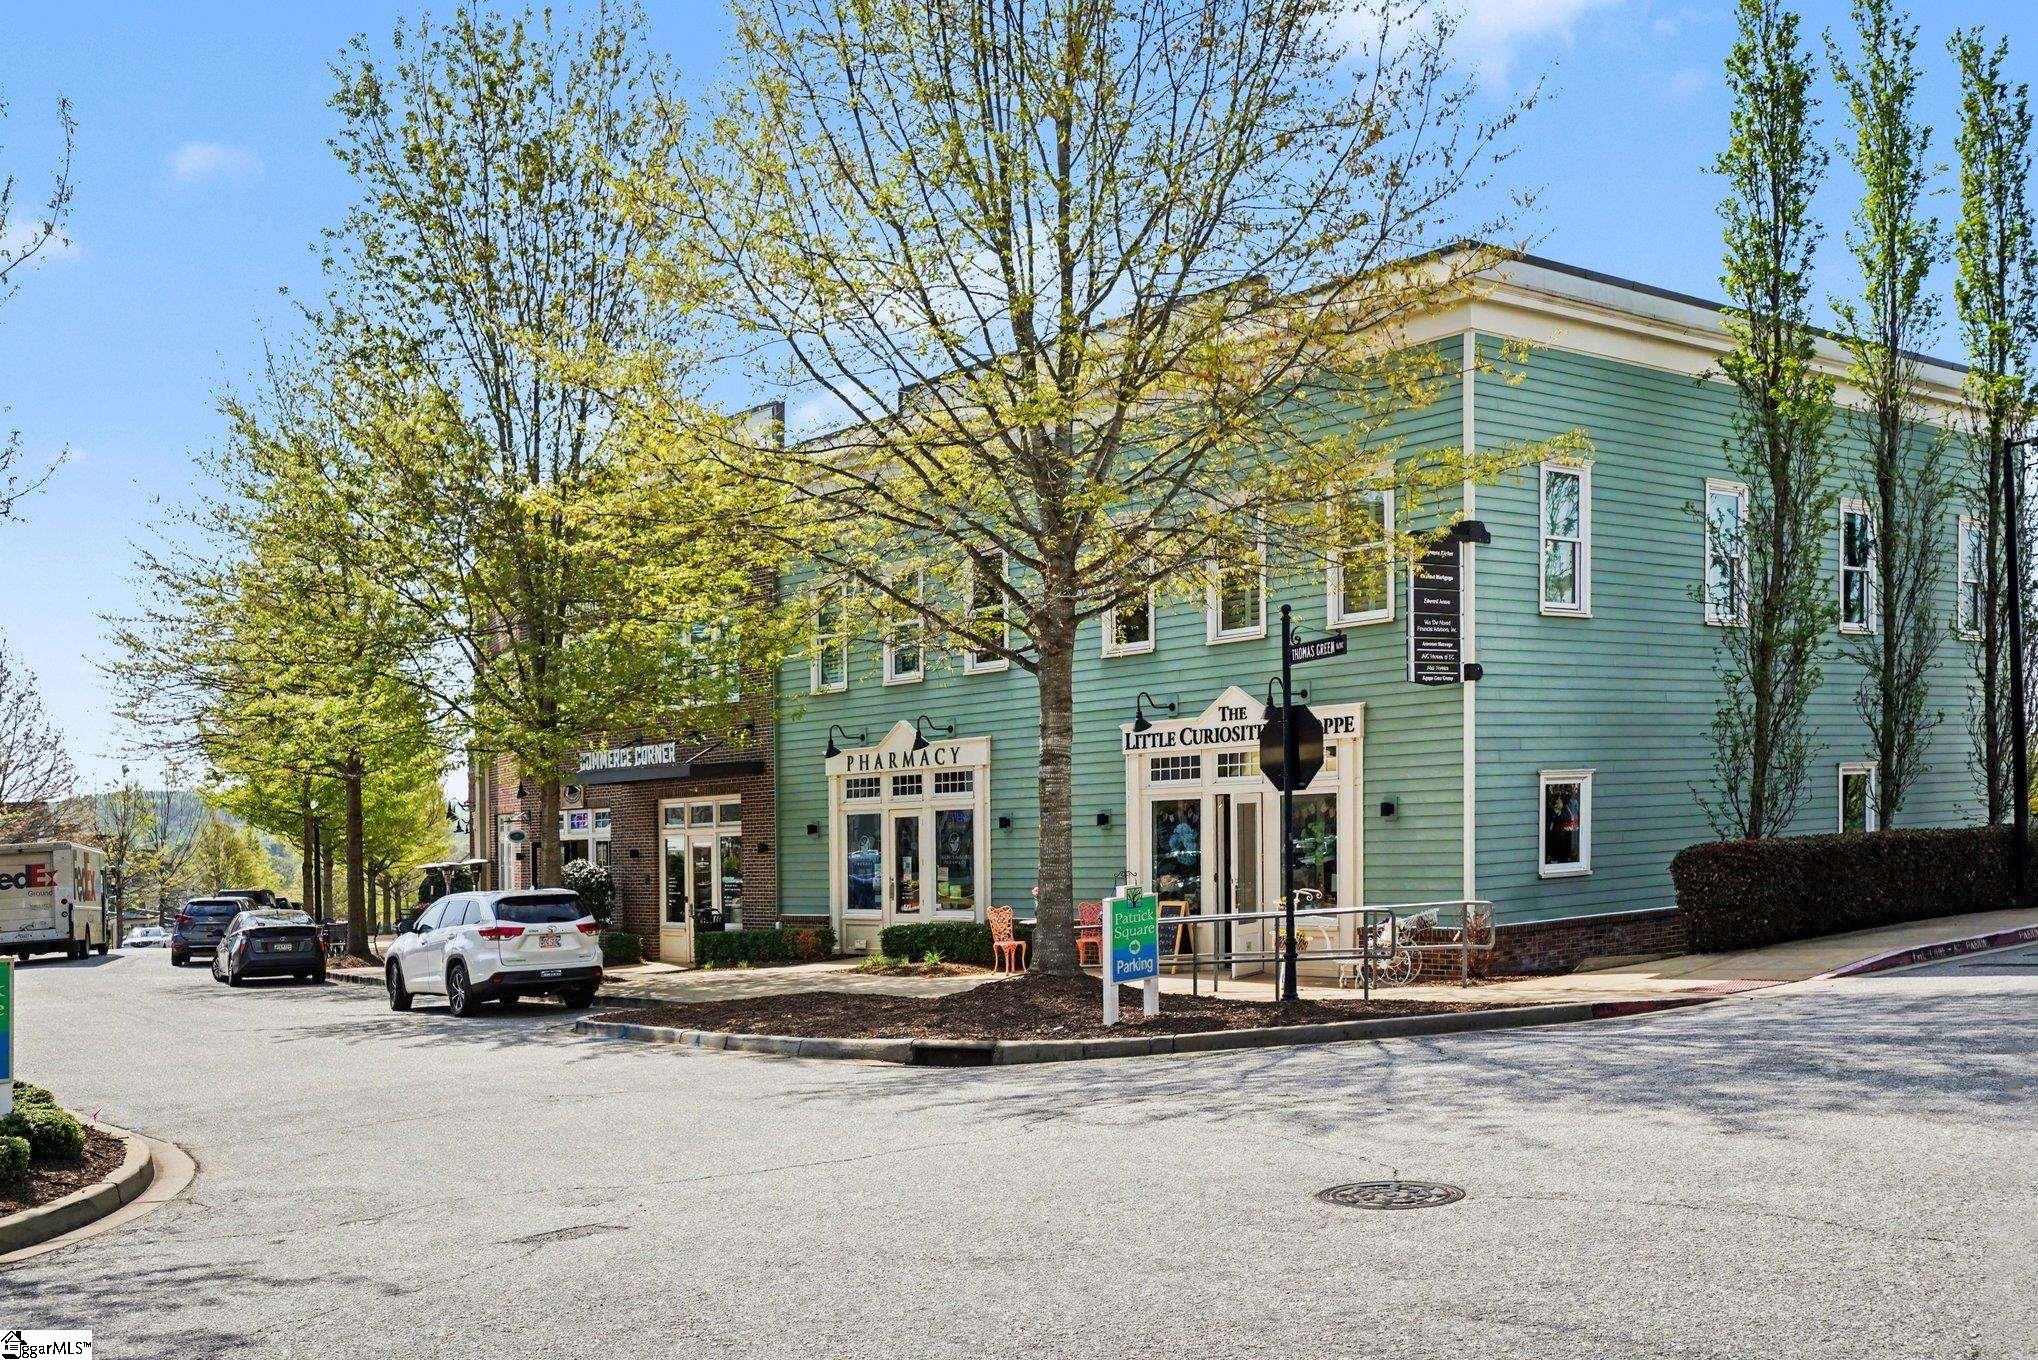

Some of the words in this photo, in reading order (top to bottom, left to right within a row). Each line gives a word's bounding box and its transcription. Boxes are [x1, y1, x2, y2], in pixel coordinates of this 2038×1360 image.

[1291, 645, 1315, 661] THOMAS
[1316, 641, 1335, 656] GREEN
[1218, 706, 1247, 722] THE
[1125, 731, 1176, 750] LITTLE
[1322, 716, 1355, 735] PPE
[580, 748, 632, 771] COMMERCE
[634, 742, 676, 767] CORNER
[846, 747, 960, 772] PHARMACY
[0, 864, 58, 890] edEx
[1115, 910, 1154, 925] Patrick
[1114, 924, 1155, 940] Square
[1116, 957, 1153, 974] Parking
